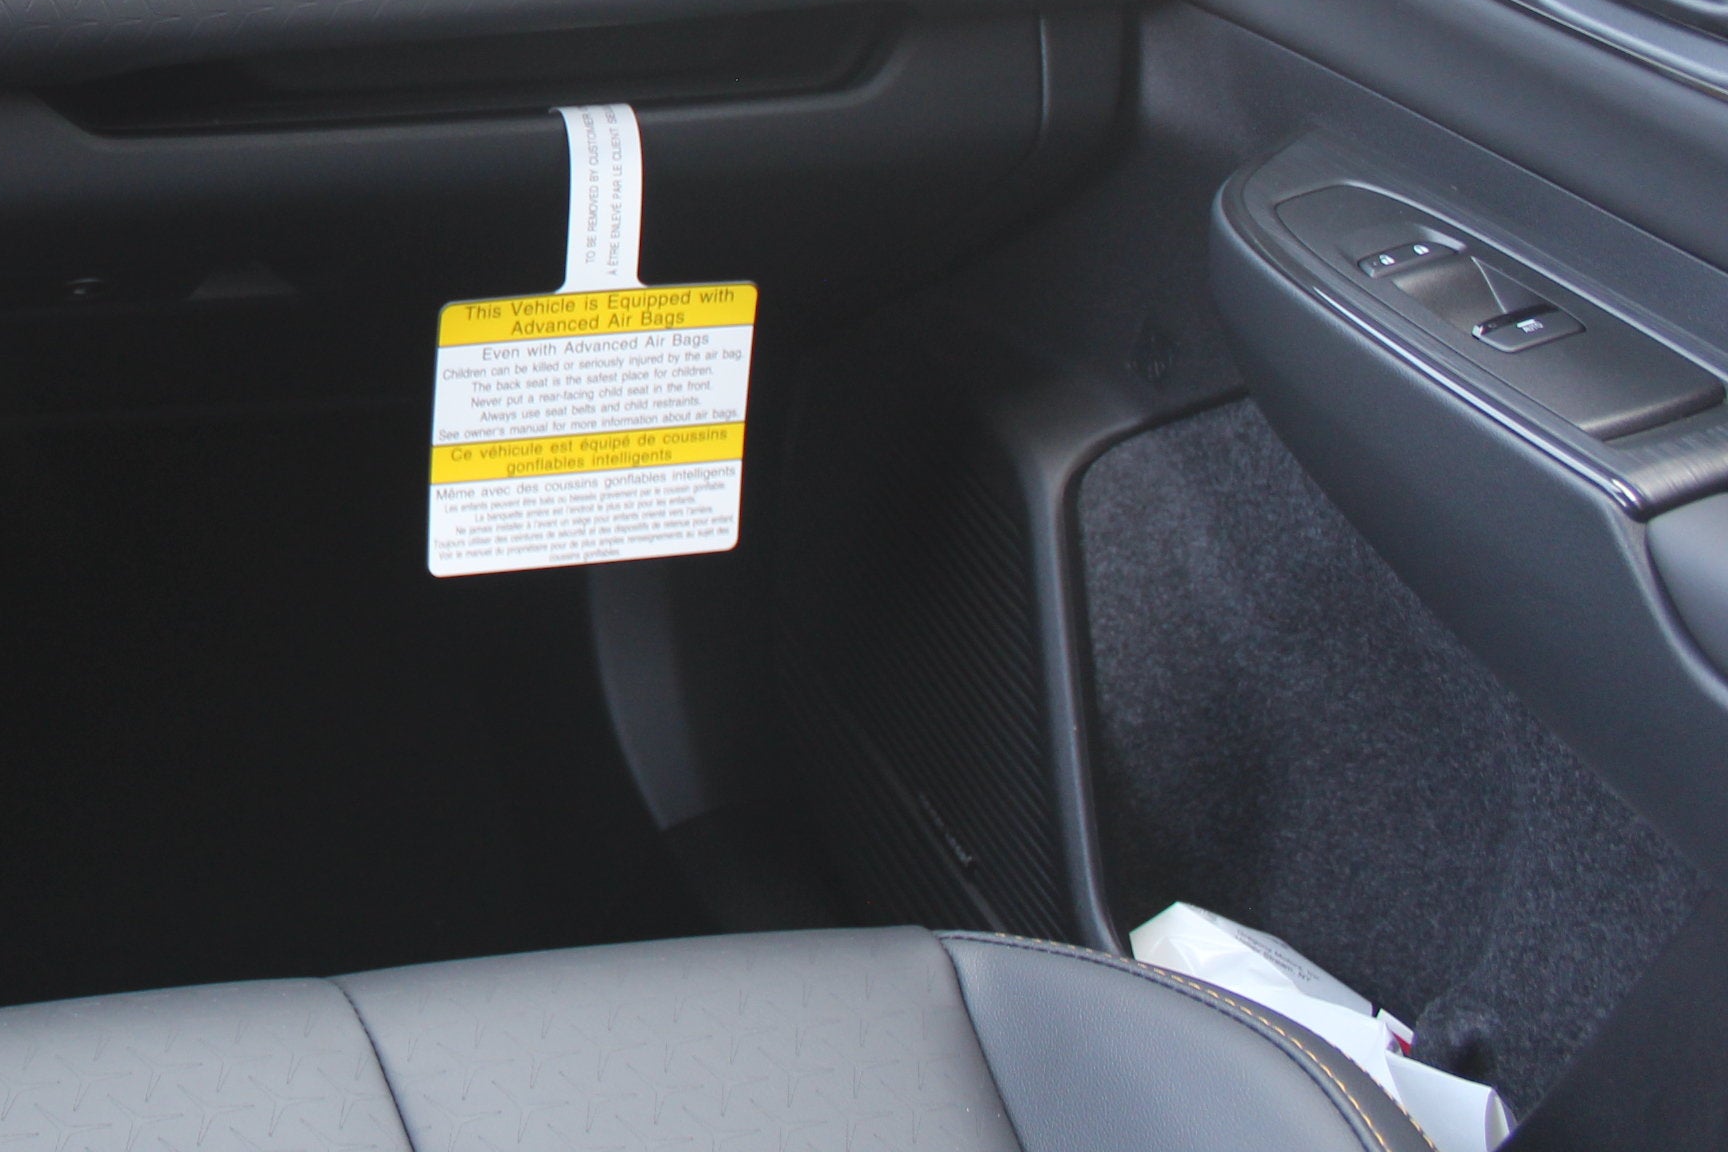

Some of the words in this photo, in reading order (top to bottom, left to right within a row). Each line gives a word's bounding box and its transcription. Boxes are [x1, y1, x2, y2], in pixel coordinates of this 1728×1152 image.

[582, 113, 599, 166] CUSTOMER
[609, 127, 622, 161] CLIENT
[589, 169, 599, 182] BY
[613, 165, 622, 177] LE
[613, 179, 622, 200] PAR
[587, 185, 599, 231] REMOVED
[586, 235, 597, 248] BE
[585, 250, 596, 264] TO
[465, 304, 501, 320] This
[510, 297, 576, 316] Vehicle
[583, 295, 598, 311] is
[606, 289, 691, 312] Equipped
[699, 288, 734, 303] with
[510, 314, 600, 336] Advanced
[606, 312, 632, 328] Air
[638, 308, 685, 328] Bags
[481, 345, 521, 361] Even
[525, 342, 557, 357] with
[563, 336, 639, 354] Advanced
[644, 334, 665, 348] Air
[670, 331, 710, 349] Bags
[442, 365, 487, 380] Children
[490, 365, 510, 376] can
[513, 363, 528, 375] be
[531, 360, 560, 373] killed
[562, 360, 574, 371] or
[578, 356, 624, 370] seriously
[628, 352, 664, 367] injured
[666, 351, 680, 364] by
[683, 350, 701, 362] the
[704, 350, 718, 360] air
[471, 380, 492, 393] The
[495, 378, 521, 391] back
[525, 377, 548, 389] seat
[551, 375, 561, 387] is
[564, 373, 582, 385] the
[585, 371, 618, 384] safest
[620, 369, 650, 383] place
[652, 367, 667, 379] for
[469, 394, 503, 408] Never
[504, 394, 524, 407] put
[537, 388, 595, 404] rear-facing
[597, 385, 624, 398] child
[626, 384, 650, 396] seat
[651, 382, 663, 394] in
[665, 381, 684, 393] the
[479, 408, 517, 423] Always
[520, 408, 541, 419] use
[544, 405, 568, 417] seat
[570, 402, 596, 415] belts
[600, 401, 621, 413] and
[623, 398, 649, 411] child
